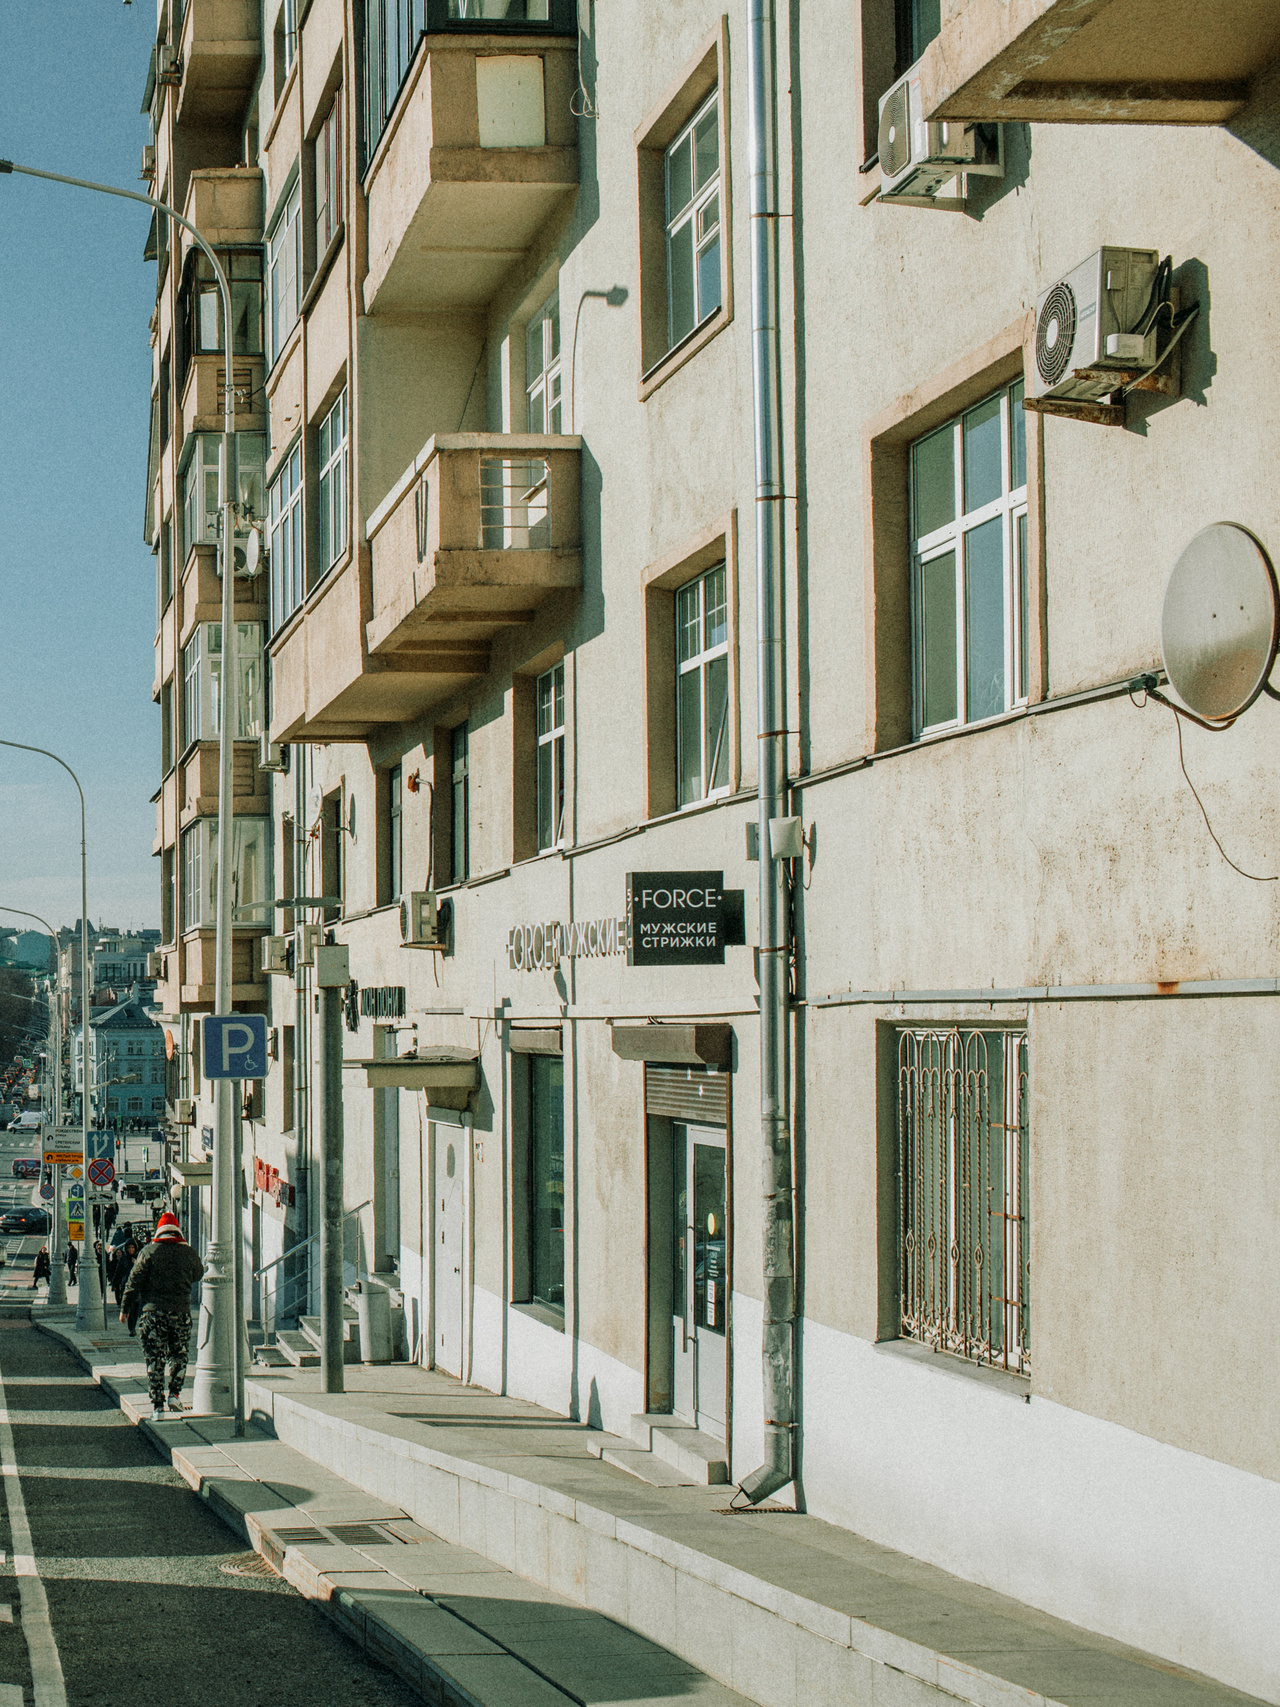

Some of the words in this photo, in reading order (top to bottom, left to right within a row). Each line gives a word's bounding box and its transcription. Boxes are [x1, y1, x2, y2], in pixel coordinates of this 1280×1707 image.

[641, 888, 717, 909] FORCE
[640, 922, 717, 934] МУЖСКИЕ
[642, 936, 716, 948] СТРИЖКИ
[222, 1024, 255, 1071] P
